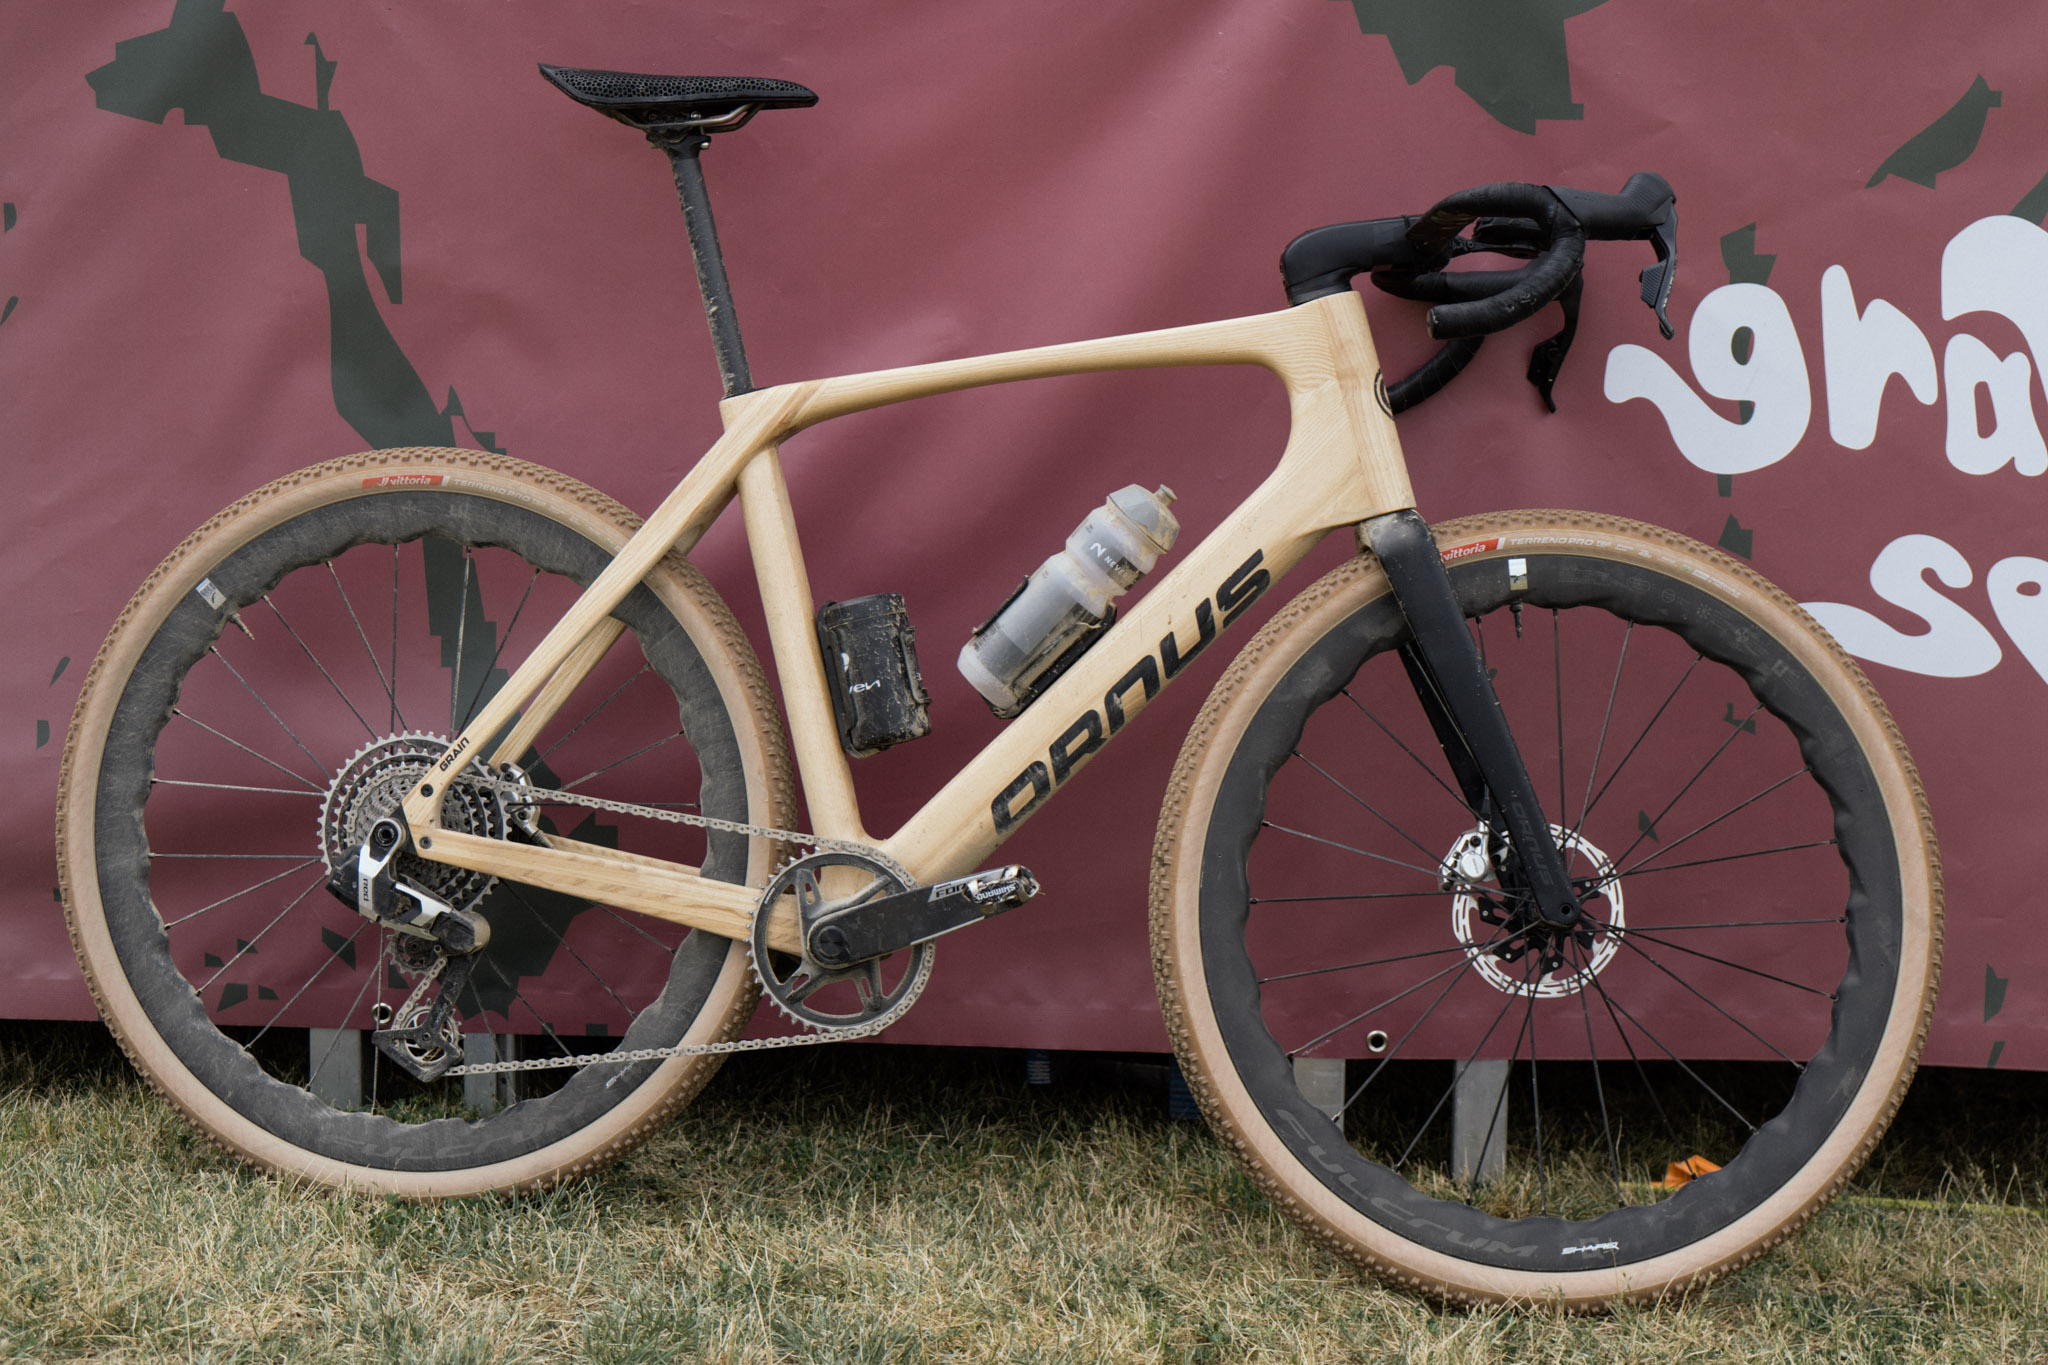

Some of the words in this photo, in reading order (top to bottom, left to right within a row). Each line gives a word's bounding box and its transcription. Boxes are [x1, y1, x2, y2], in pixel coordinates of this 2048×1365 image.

[390, 475, 431, 486] vittoria
[507, 488, 531, 501] PRO
[1443, 543, 1486, 562] vittoria
[1511, 537, 1567, 545] TERRENO
[1568, 538, 1594, 546] PRO
[440, 737, 469, 771] GRAIN
